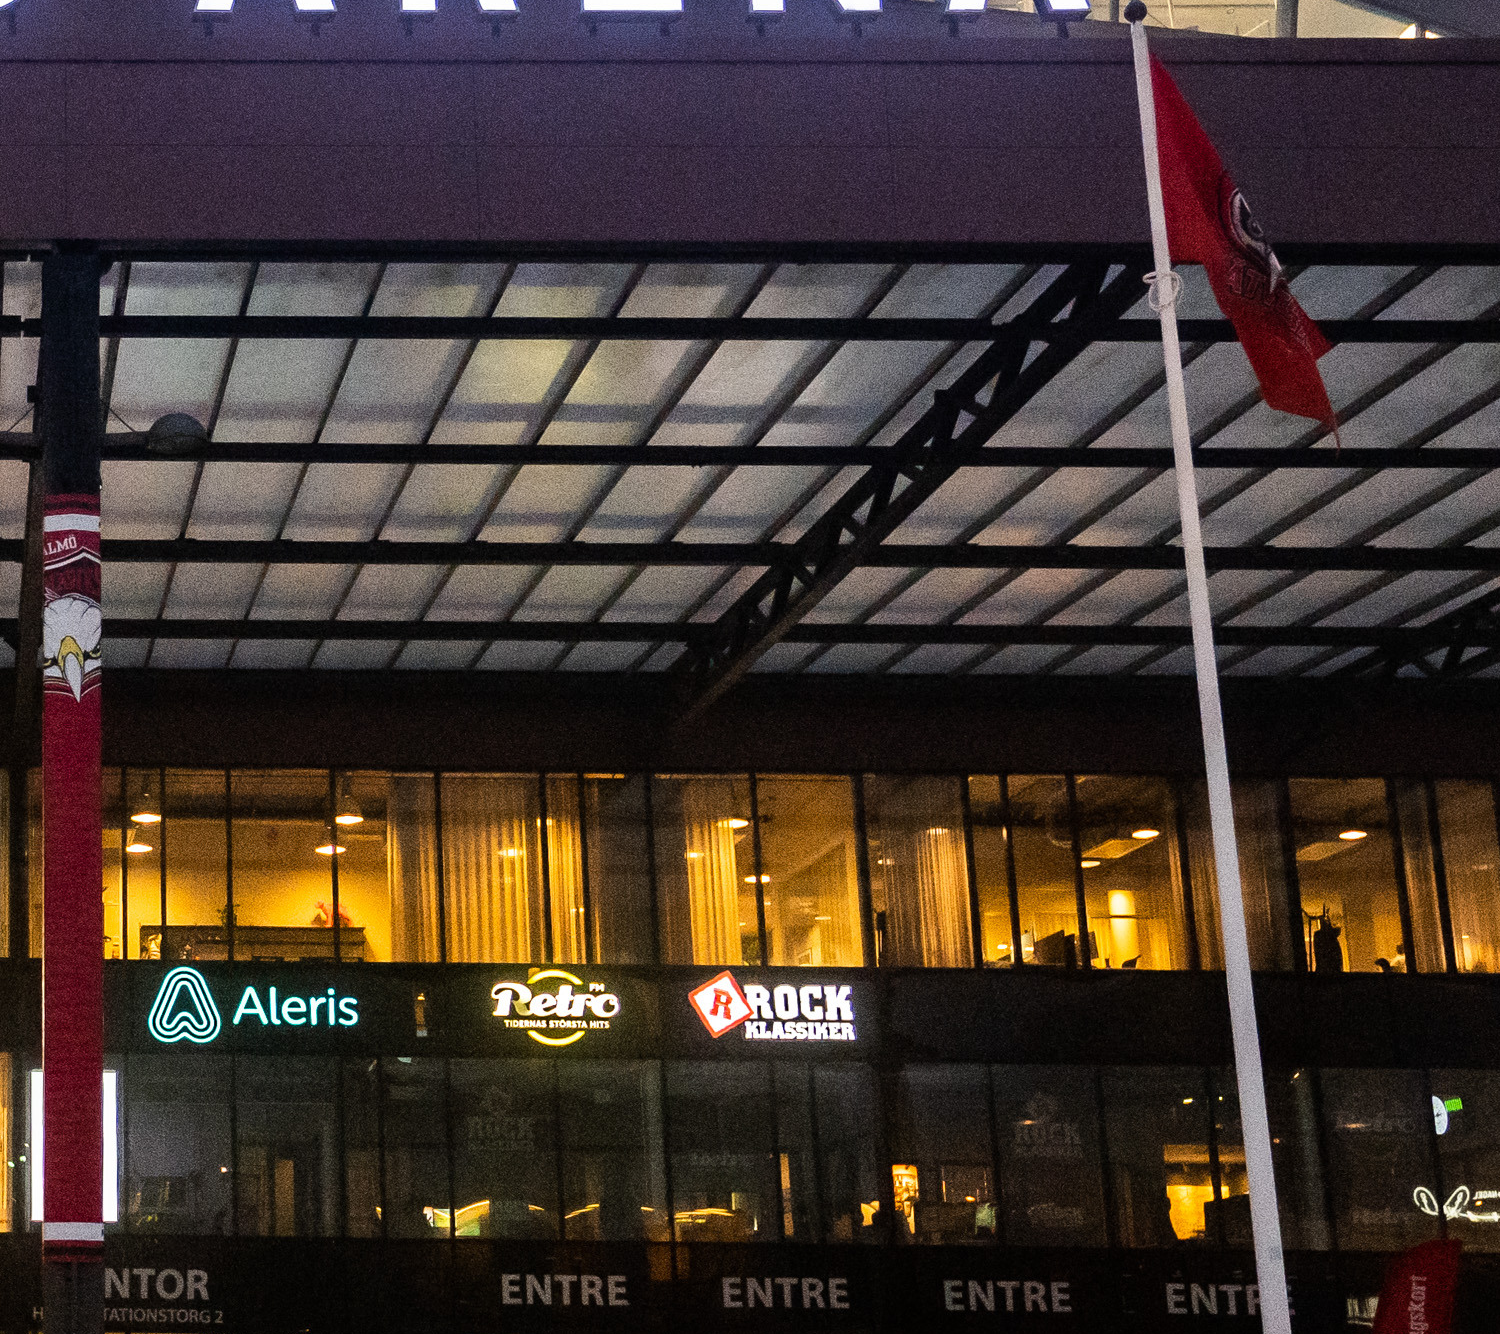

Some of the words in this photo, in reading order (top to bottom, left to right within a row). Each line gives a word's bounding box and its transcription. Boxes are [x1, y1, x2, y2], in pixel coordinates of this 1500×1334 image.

[43, 533, 78, 556] LMÖ
[232, 985, 360, 1027] Aleris
[490, 982, 620, 1018] Retro
[588, 983, 605, 992] FM
[742, 983, 854, 1021] ROCK
[504, 1019, 547, 1028] TIDERNAS
[548, 1019, 588, 1029] STÖRSTA
[589, 1020, 610, 1029] HITS
[743, 1021, 857, 1041] KLASSIKER
[103, 1267, 210, 1301] NTOR
[501, 1273, 630, 1308] ENTRE
[721, 1276, 851, 1310] ENTRE
[943, 1280, 1073, 1314] ENTRE
[103, 1307, 210, 1324] TATIONSTORG
[214, 1310, 224, 1324] 2
